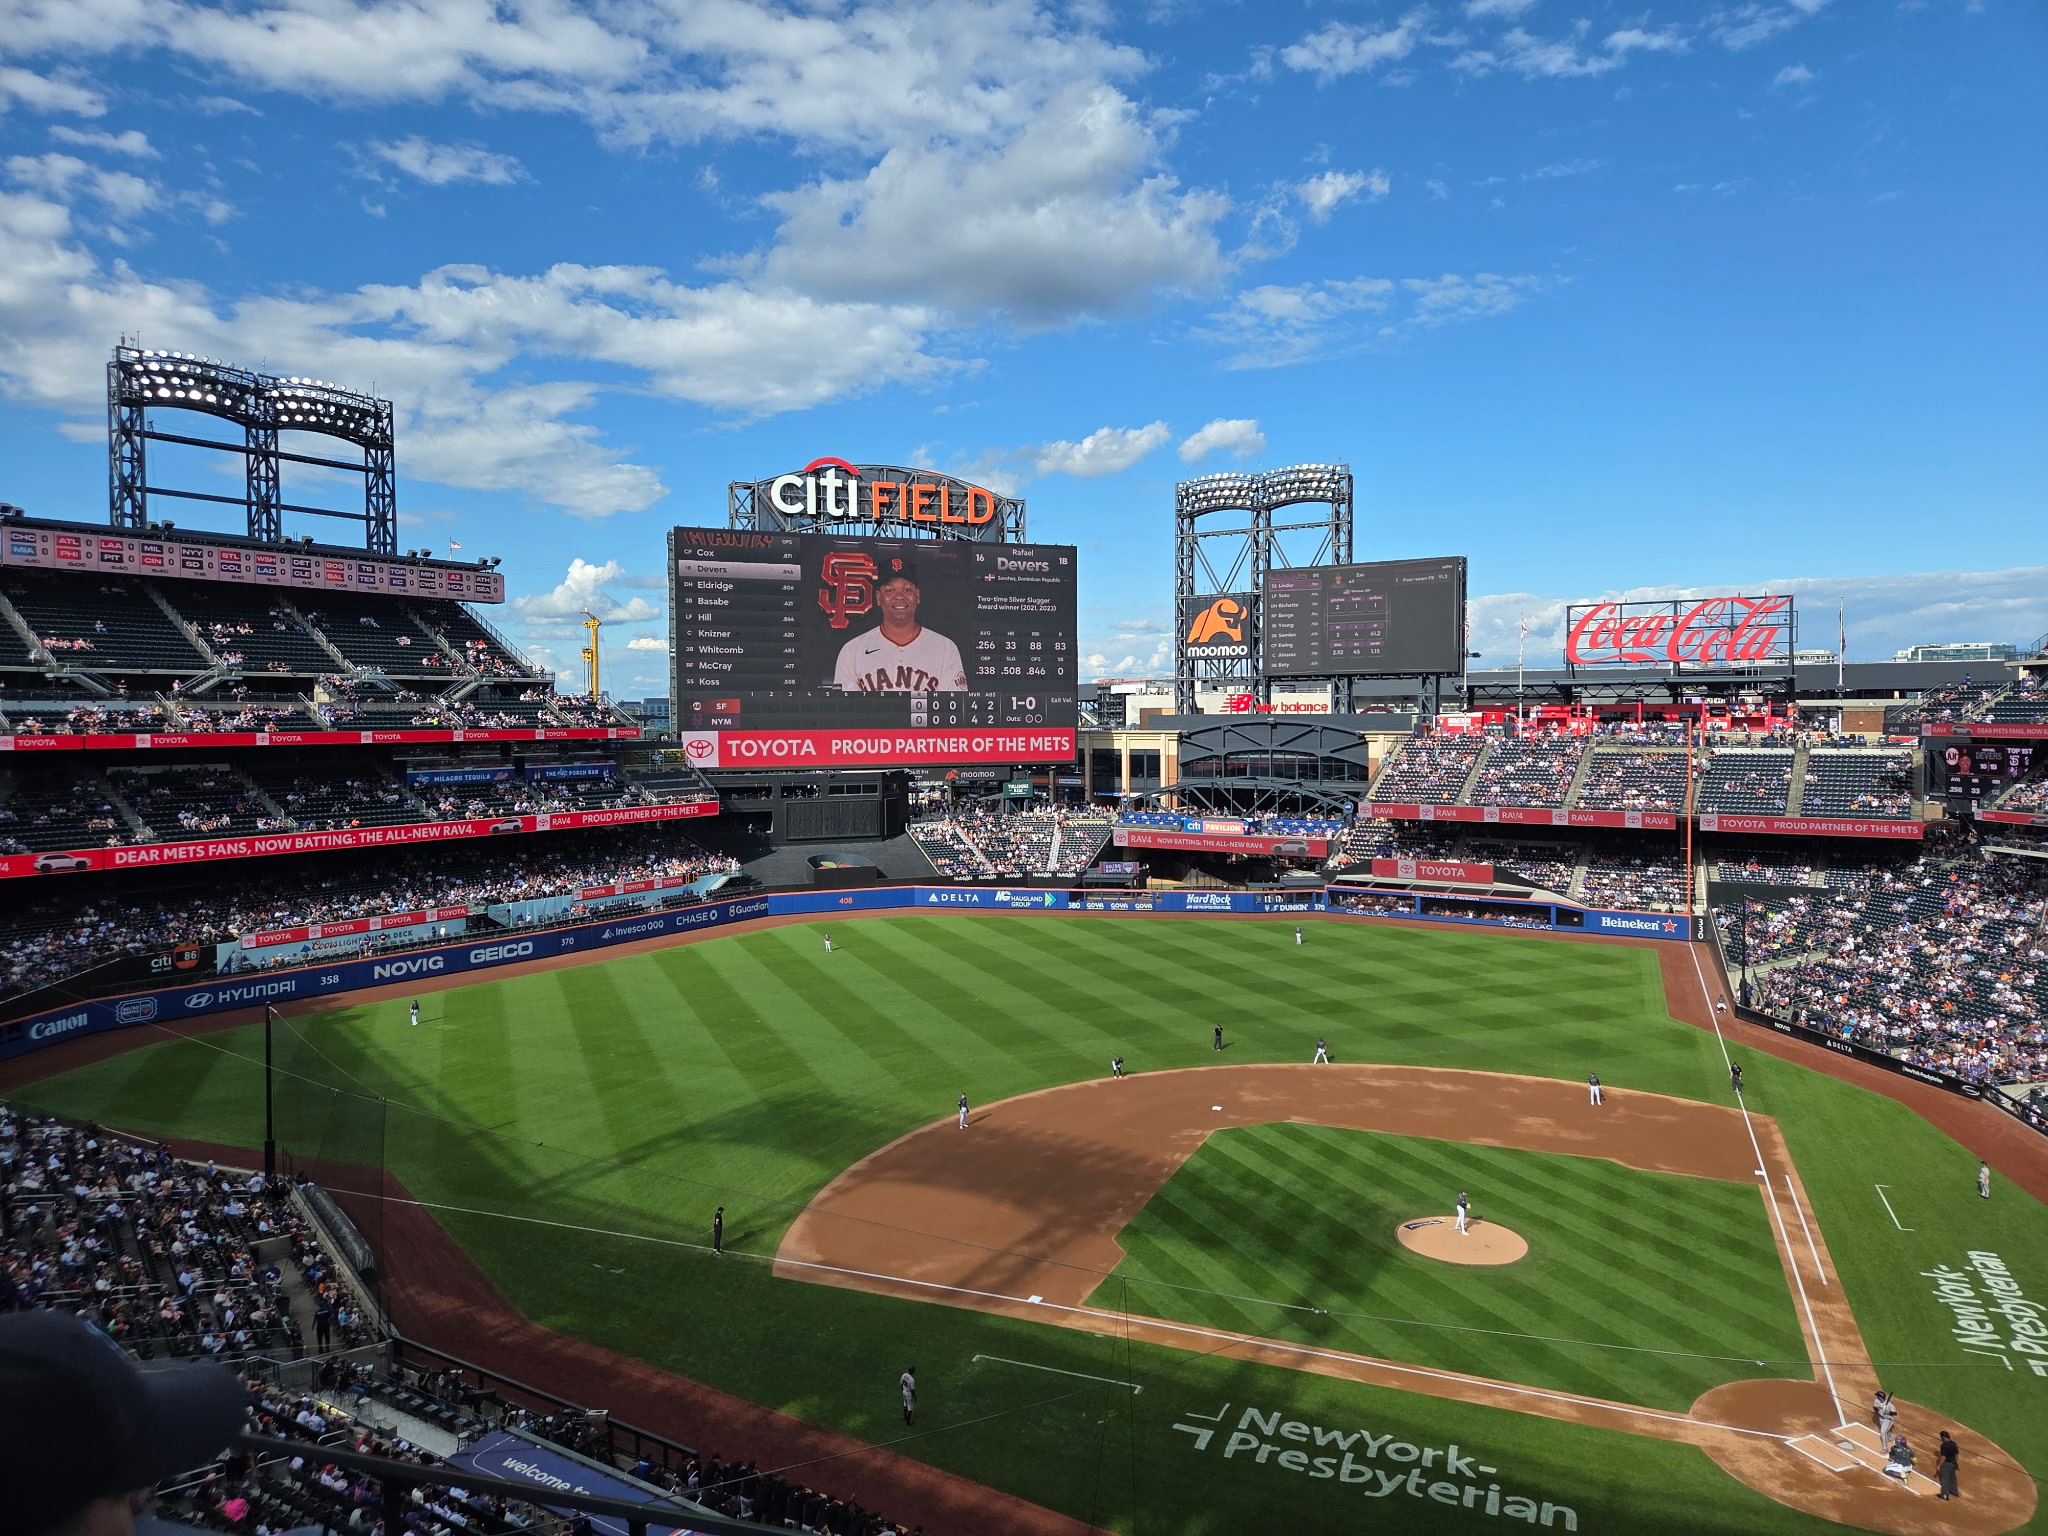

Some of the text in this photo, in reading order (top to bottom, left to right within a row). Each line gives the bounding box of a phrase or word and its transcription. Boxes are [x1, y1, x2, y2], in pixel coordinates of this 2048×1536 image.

[770, 466, 995, 524] citi FIELD
[11, 533, 36, 541] CHC
[59, 537, 79, 545] ATL
[13, 546, 35, 554] MIA
[101, 541, 122, 549] LAA
[144, 545, 162, 553] MIL
[60, 550, 79, 558] PHI
[103, 553, 121, 561] PIT
[182, 548, 203, 556] NYY
[221, 552, 240, 560] STL
[696, 548, 715, 557] Cox
[1012, 548, 1034, 557] Rafael
[144, 557, 162, 565] CIN
[185, 560, 200, 568] SD
[975, 553, 1069, 572] 16 Devers 1B
[697, 565, 728, 573] Devers
[697, 581, 734, 592] Eldridge
[697, 597, 730, 606] Basabe
[1026, 597, 1051, 605] Slugger
[1039, 604, 1057, 612] 2023)
[698, 613, 712, 621] Hill
[698, 629, 731, 638] Knizner
[698, 645, 744, 654] Whitcomb
[975, 641, 1067, 650] .256 33 88 83
[1187, 645, 1248, 657] moomoo
[698, 661, 733, 672] McCray
[975, 666, 1064, 676] .338 .508 .846 0
[699, 677, 720, 686] Koss
[715, 702, 728, 710] SF
[1011, 696, 1036, 710] 1-0
[1281, 702, 1329, 712] balance
[374, 733, 401, 741] TOYOTA
[17, 739, 57, 747] TOYOTA
[727, 736, 1070, 757] TOYOTA PROUD PARTNER OF THE METS
[1975, 751, 2003, 760] DEVERS
[434, 773, 490, 782] MILAGRO TEQUILA
[960, 770, 995, 778] moomoo
[1374, 806, 1394, 815] RAV4
[1436, 808, 1457, 817] RAV4
[1502, 811, 1524, 820] RAV4
[552, 806, 699, 826] RAV4 PROUD PARTNER OF THE METS
[1571, 813, 1595, 823] RAV4
[1644, 816, 1669, 826] RAV4
[1187, 820, 1241, 832] citi PAVILION
[1721, 819, 1919, 834] TOYOTA PROUD PARTNER OF THE METS
[115, 824, 476, 865] DEAR METS FANS, NOW BATTING: THE ALL-NEW RAV4.
[1130, 834, 1152, 844] RAV4
[1174, 838, 1202, 846] BATTING:
[1215, 840, 1245, 848] ALL-NEW
[1419, 865, 1466, 878] TOYOTA
[625, 883, 645, 891] TOYOTA
[584, 888, 606, 897] TOYOTA
[839, 897, 853, 905] 408
[941, 893, 979, 903] DELTA
[1186, 893, 1231, 905] Hard Rock
[736, 901, 769, 915] Guardian
[1086, 902, 1104, 910] GOYA
[1280, 903, 1308, 911] DUNKIN'
[1314, 903, 1326, 911] 370
[439, 908, 466, 918] TOYOTA
[1346, 908, 1389, 917] CADILLAC
[383, 916, 412, 926] TOYOTA
[676, 912, 709, 926] CHASE
[1601, 916, 1660, 931] Heineken
[323, 924, 354, 934] TOYOTA
[615, 919, 664, 937] Invesco QQQ
[1503, 922, 1553, 931] CADILLAC
[258, 932, 292, 943] TOYOTA
[560, 937, 575, 947] 370
[311, 940, 338, 951] Coors
[184, 950, 197, 960] 86
[470, 941, 534, 964] GEICO
[151, 954, 172, 968] citi
[373, 955, 444, 980] NOVIG
[320, 974, 340, 986] 358
[218, 980, 296, 1003] HYUNDAI
[30, 1012, 88, 1040] Canon
[1774, 1022, 1791, 1032] NOVIG
[1832, 1041, 1853, 1054] DELTA
[1964, 1250, 2048, 1356] Presbyterian
[502, 1456, 572, 1492] welcome
[1223, 1431, 1578, 1532] Presbyterian
